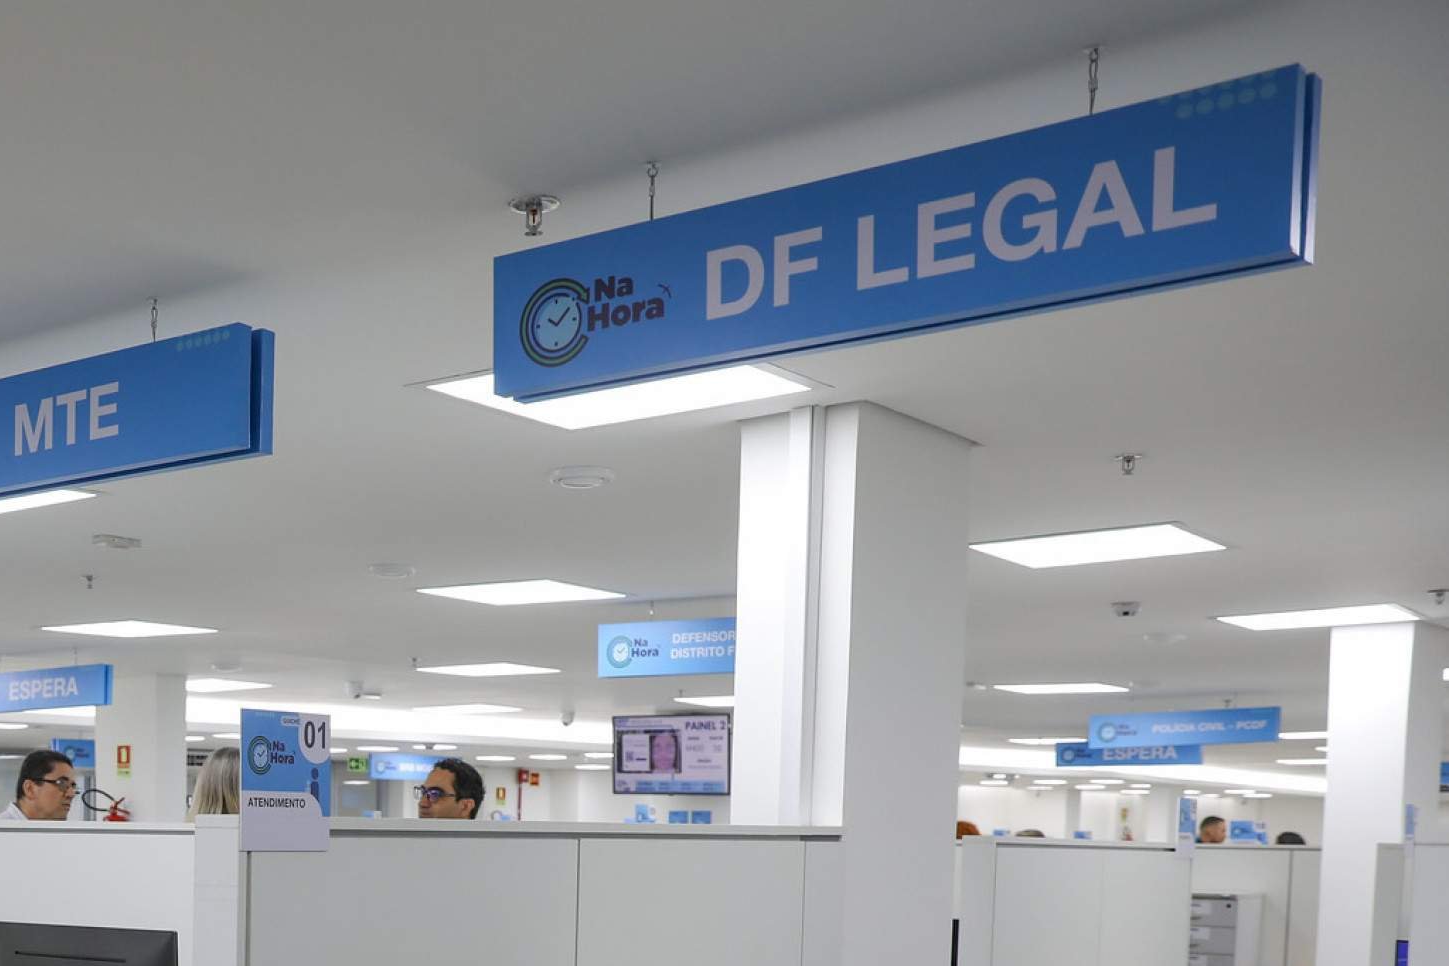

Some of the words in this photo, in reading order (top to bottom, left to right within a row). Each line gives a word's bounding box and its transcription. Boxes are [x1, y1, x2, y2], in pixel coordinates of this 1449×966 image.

[705, 226, 824, 321] DF
[856, 147, 1218, 291] LEGAL
[593, 272, 634, 306] Na
[587, 294, 666, 333] Hora
[14, 381, 119, 457] MTE
[634, 638, 648, 647] Na
[631, 647, 659, 658] Hora
[670, 646, 724, 660] DISTRITO
[9, 676, 79, 701] ESPERA
[304, 721, 326, 749] 01
[272, 741, 285, 752] Na
[1102, 746, 1178, 761] ESPERA
[270, 752, 295, 764] Hora
[247, 797, 306, 809] ATENDIMENTO
